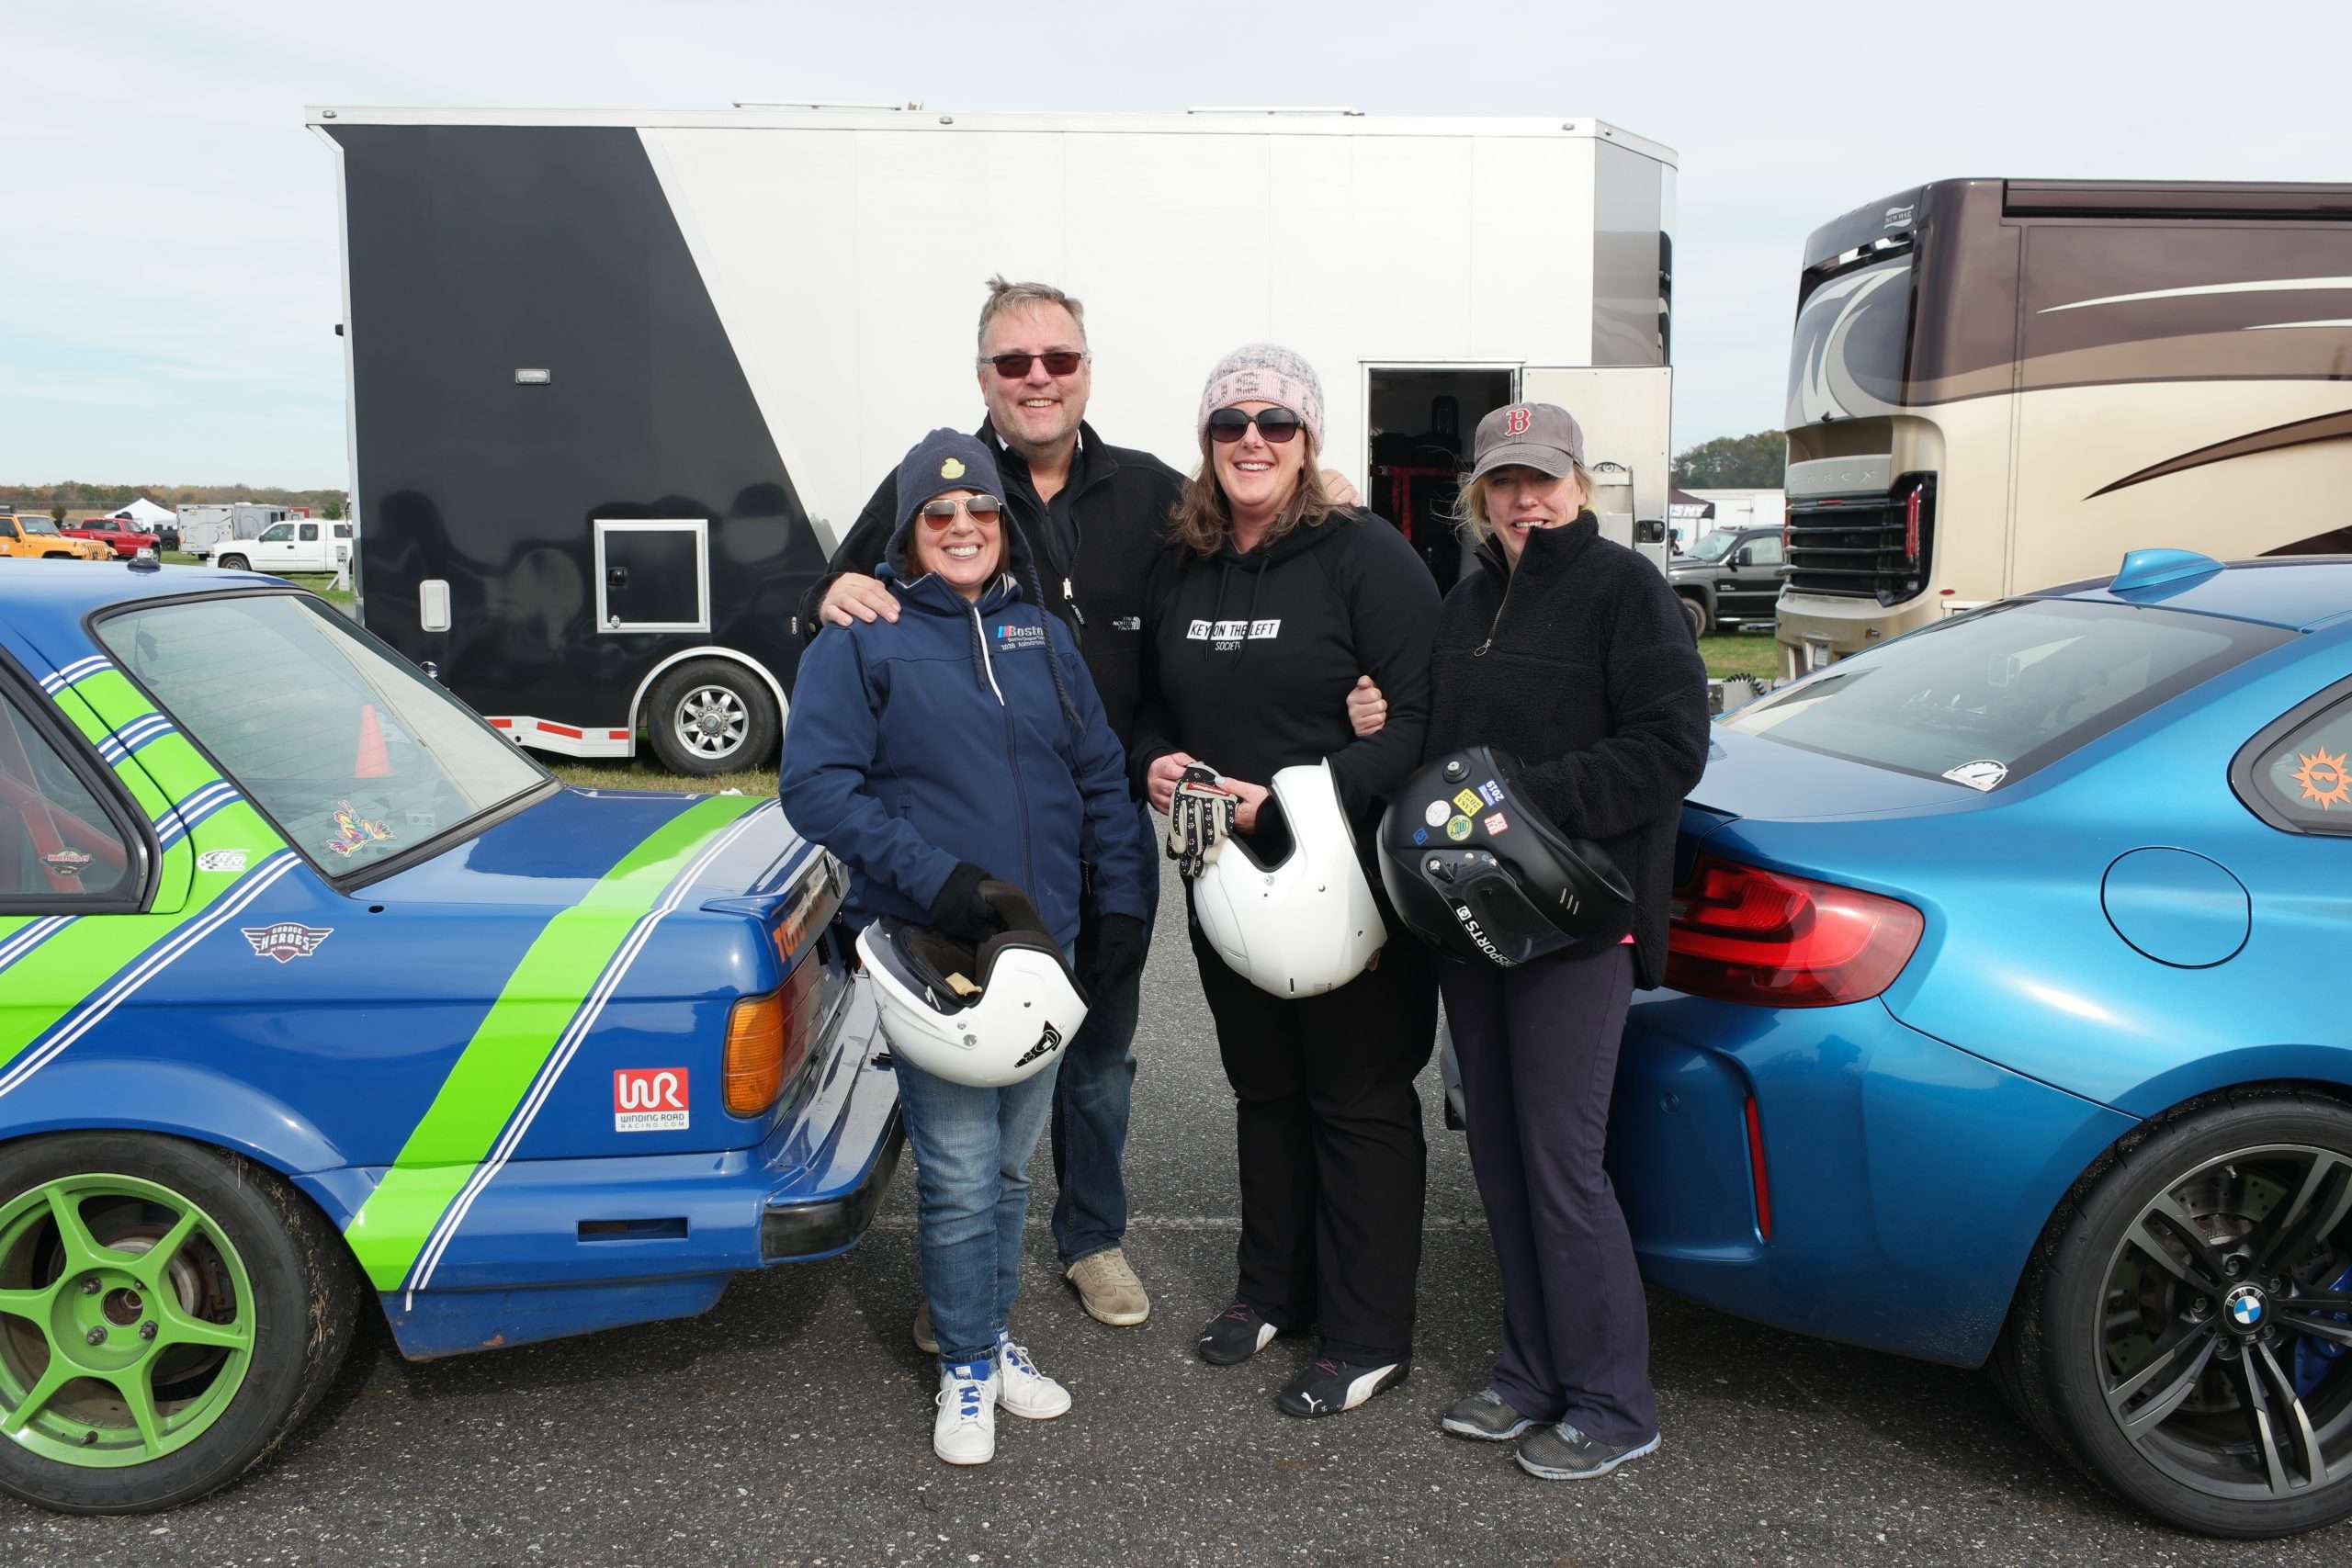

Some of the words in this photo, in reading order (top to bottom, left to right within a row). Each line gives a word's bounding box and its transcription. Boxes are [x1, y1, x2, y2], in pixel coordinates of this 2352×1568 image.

[1505, 409, 1530, 435] B
[1009, 626, 1044, 637] Bosto
[1191, 625, 1212, 637] KEY
[1213, 625, 1227, 637] ON
[1230, 624, 1248, 637] THE
[1250, 623, 1275, 636] LEFT
[1486, 780, 1505, 802] 2019
[272, 926, 302, 935] GARAGE
[261, 933, 310, 951] HEROES
[619, 1072, 684, 1110] WR
[621, 1114, 658, 1122] WINDING
[661, 1113, 684, 1122] ROAD
[2226, 1289, 2264, 1308] BMW
